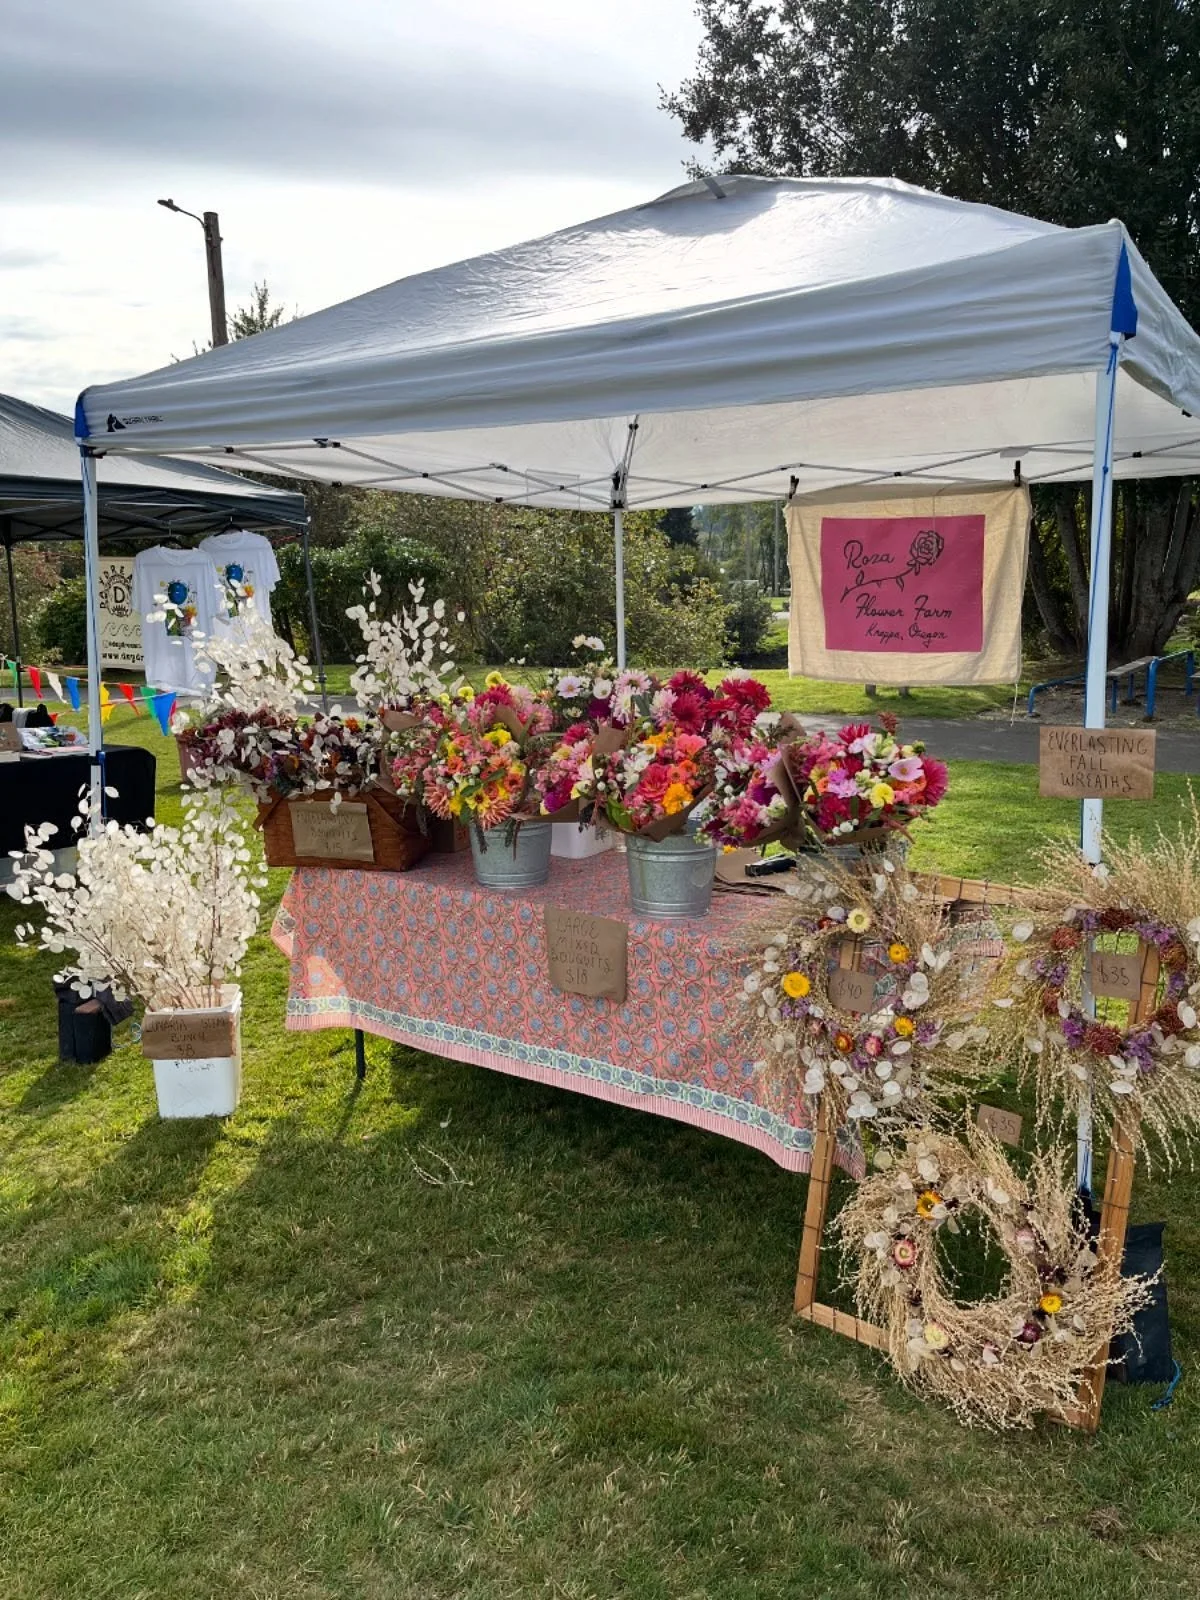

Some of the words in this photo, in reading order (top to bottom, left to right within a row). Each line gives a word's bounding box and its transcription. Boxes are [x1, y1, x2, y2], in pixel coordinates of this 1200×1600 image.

[844, 539, 895, 570] Roza
[855, 593, 905, 620] Flower
[914, 595, 953, 620] Farm
[908, 620, 948, 648] Oregon
[1047, 730, 1148, 755] EVERLASTING
[1069, 754, 1109, 772] FALL
[1060, 772, 1135, 793] WREATHS
[556, 916, 600, 940] LARGE
[555, 935, 601, 957] MIXED
[565, 968, 589, 985] $18
[1096, 959, 1131, 987] $35
[838, 977, 862, 1000] $40
[987, 1111, 1016, 1136] $35
